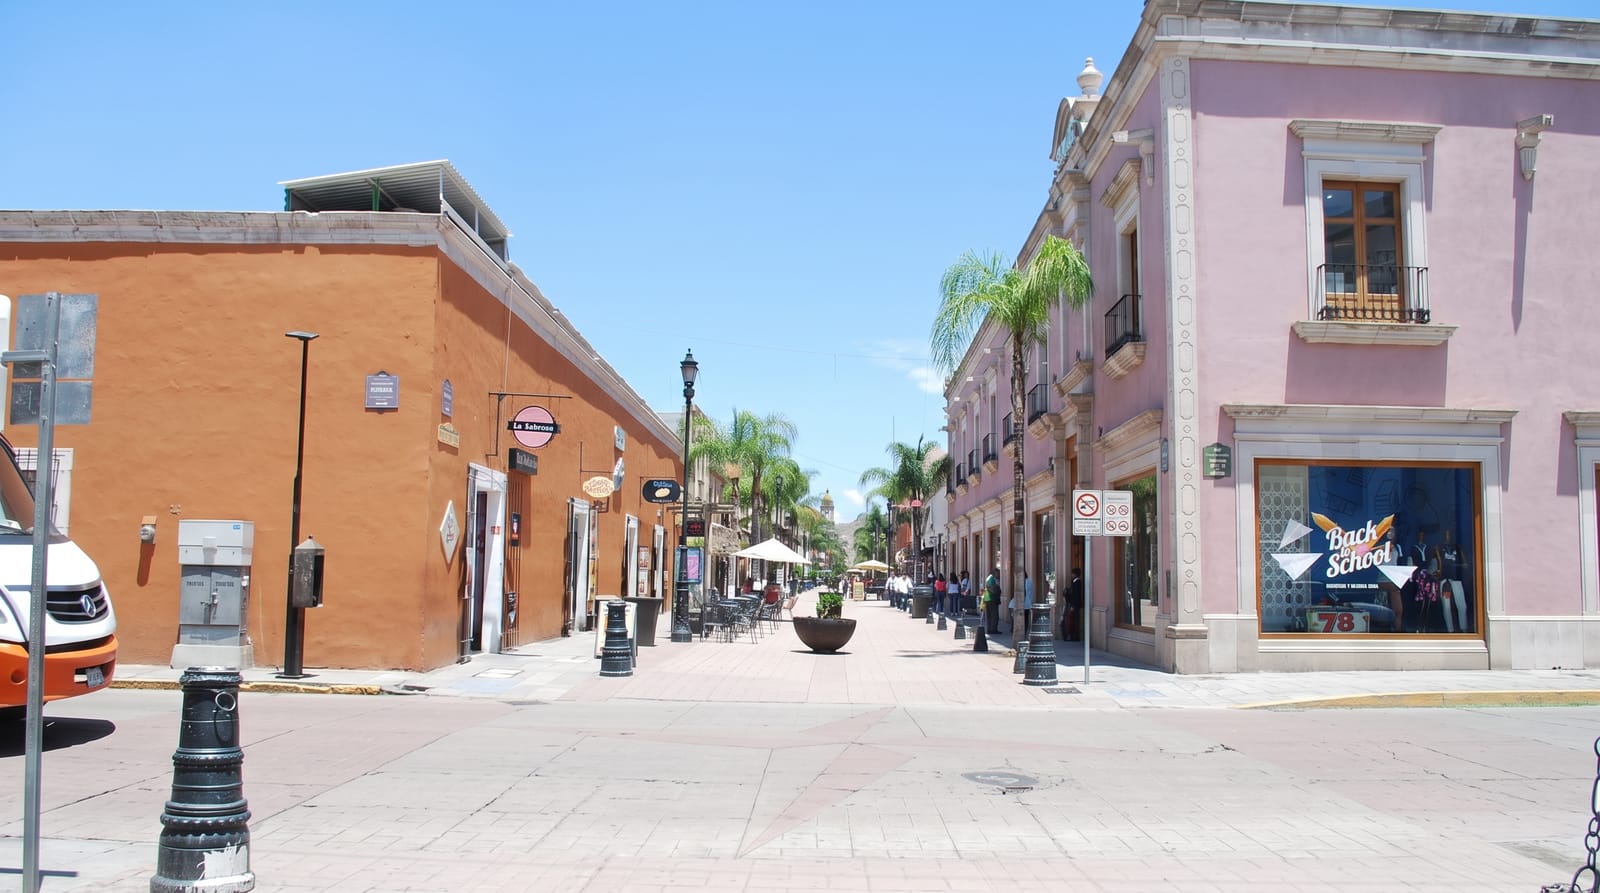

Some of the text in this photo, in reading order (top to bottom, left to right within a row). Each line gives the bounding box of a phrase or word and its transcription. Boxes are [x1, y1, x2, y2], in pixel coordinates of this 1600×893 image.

[513, 422, 522, 430] La
[1326, 520, 1377, 550] Back
[1326, 541, 1391, 578] School
[1340, 546, 1351, 558] to
[1318, 612, 1355, 633] 78
